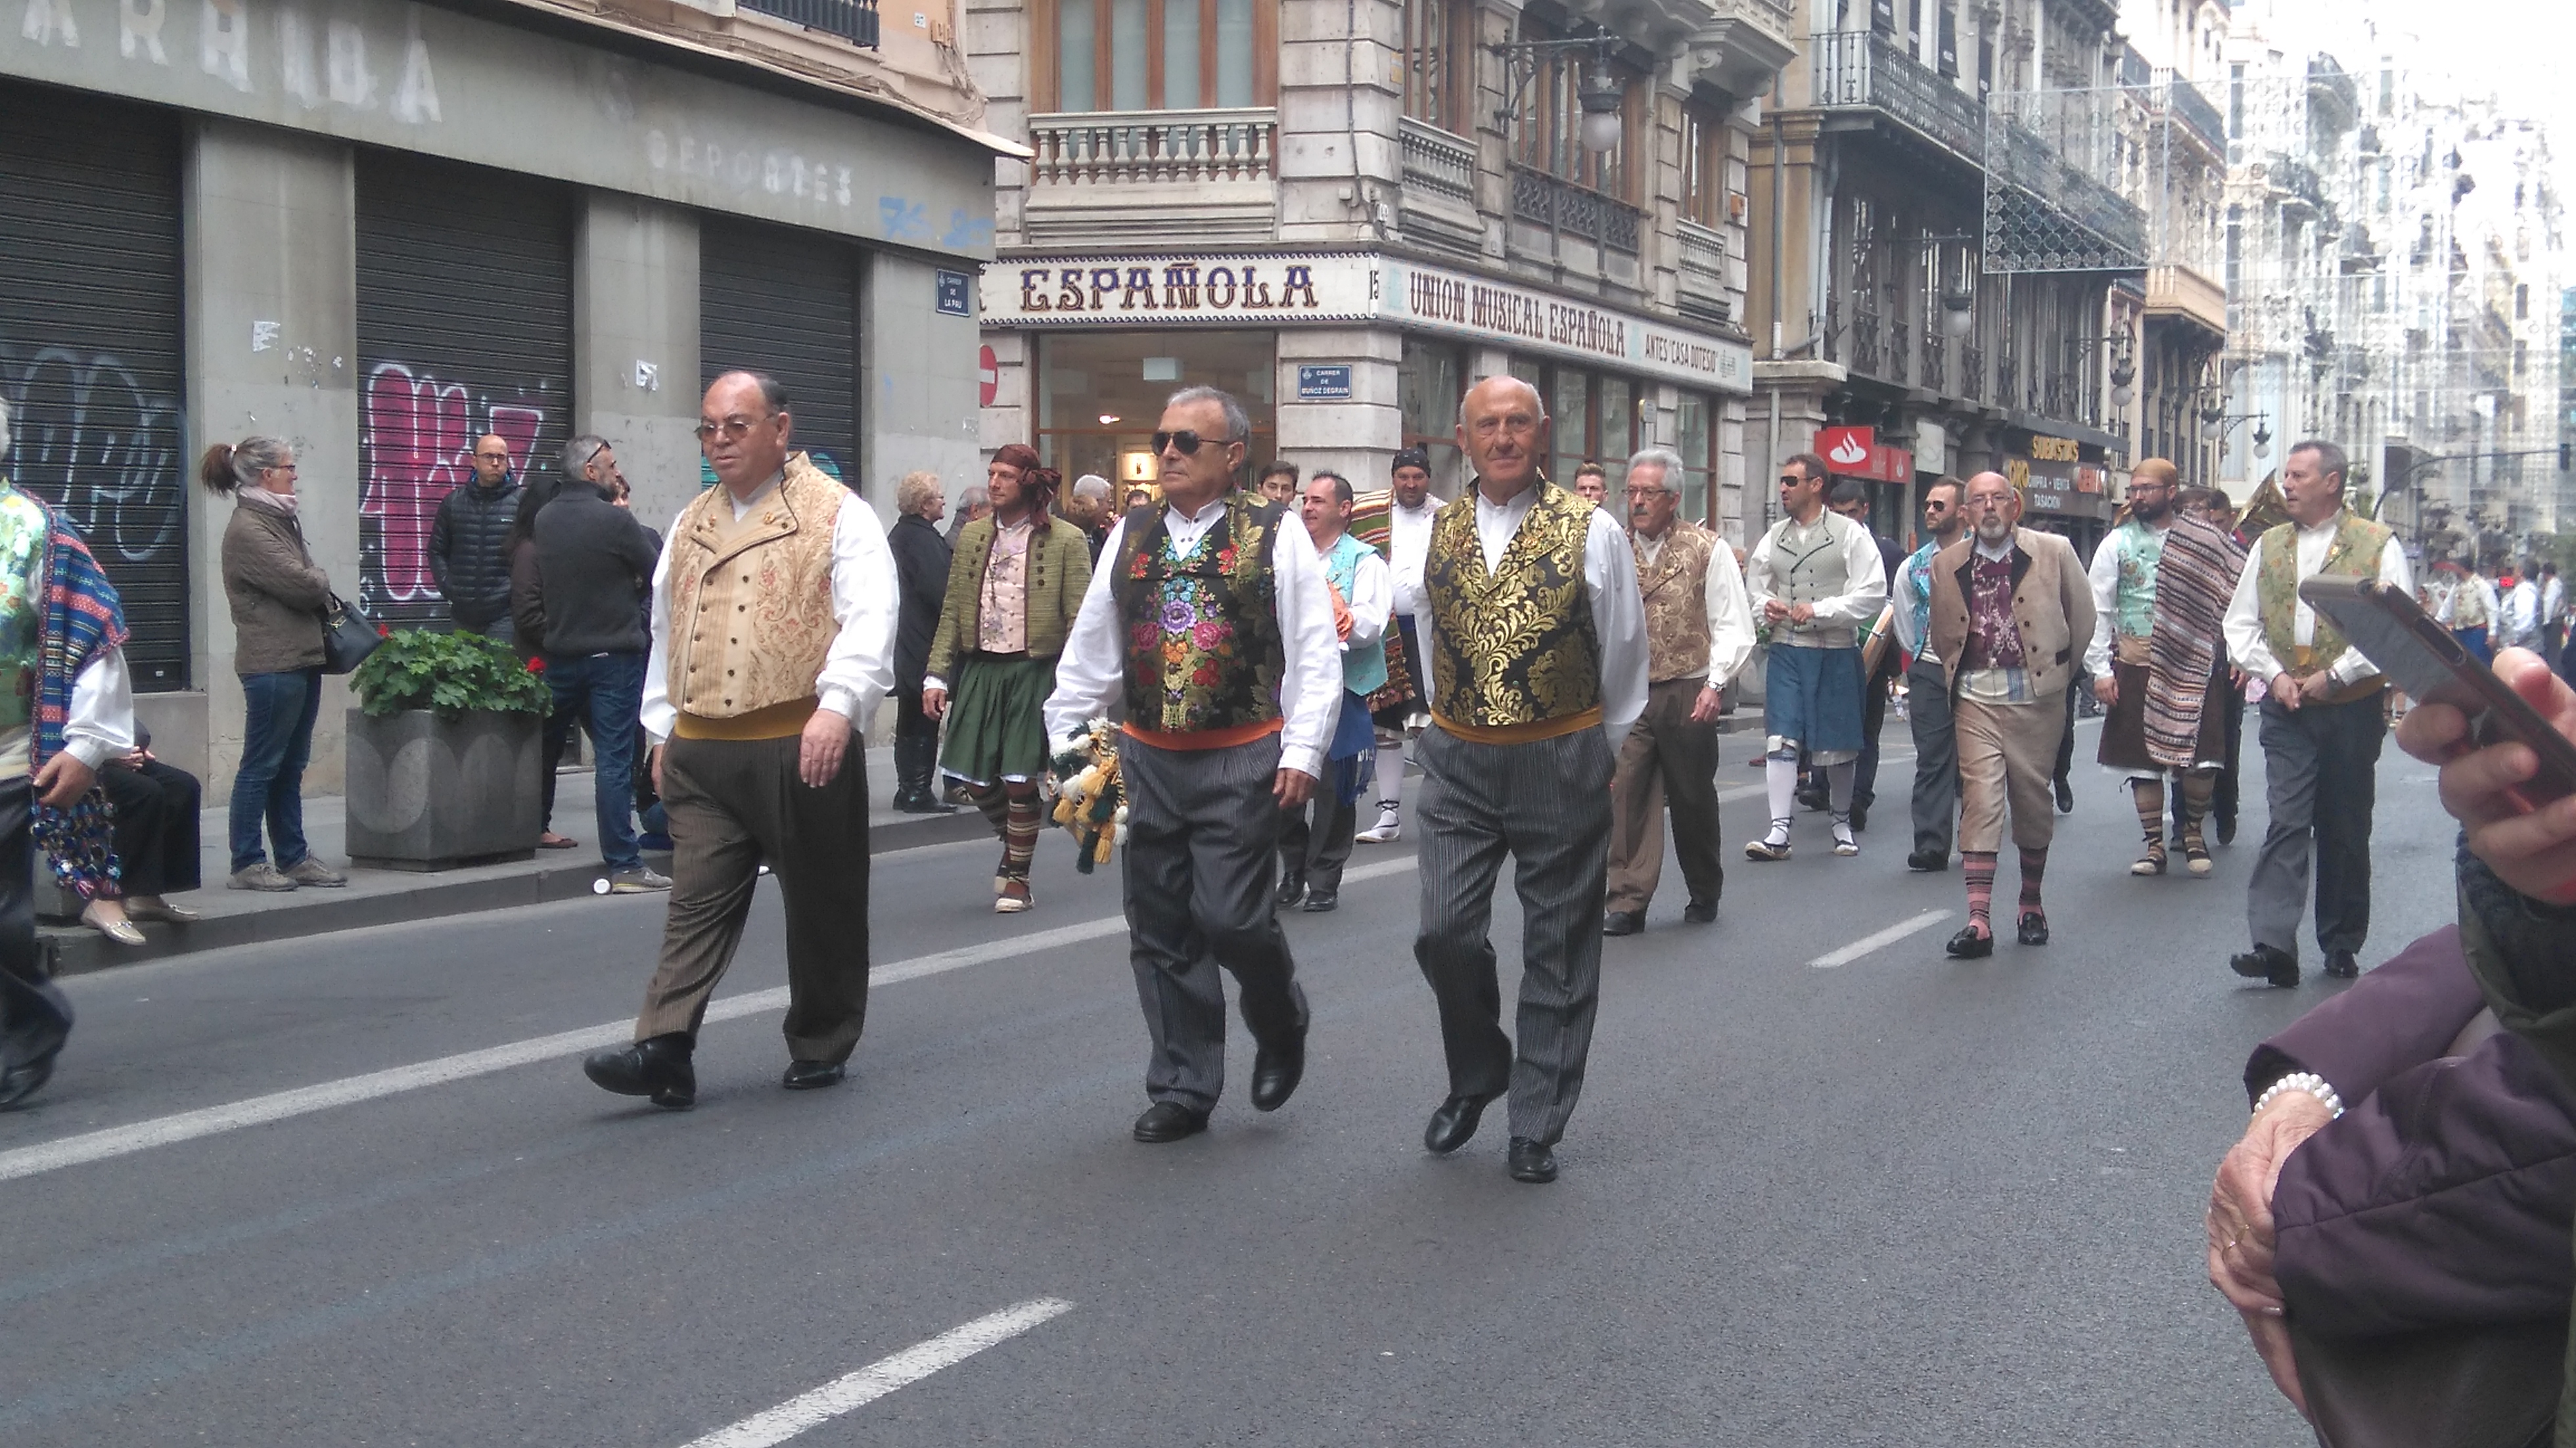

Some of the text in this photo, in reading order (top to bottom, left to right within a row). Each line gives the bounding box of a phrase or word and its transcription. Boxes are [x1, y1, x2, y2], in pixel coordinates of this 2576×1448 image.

[1020, 262, 1318, 312] ESPAÑOLA
[1410, 271, 1625, 357] UNION MUSICAL ESPAÑOLA
[1645, 334, 1667, 362] ANTES
[2033, 435, 2079, 463] SUBASTAS
[2009, 459, 2029, 490] ORO
